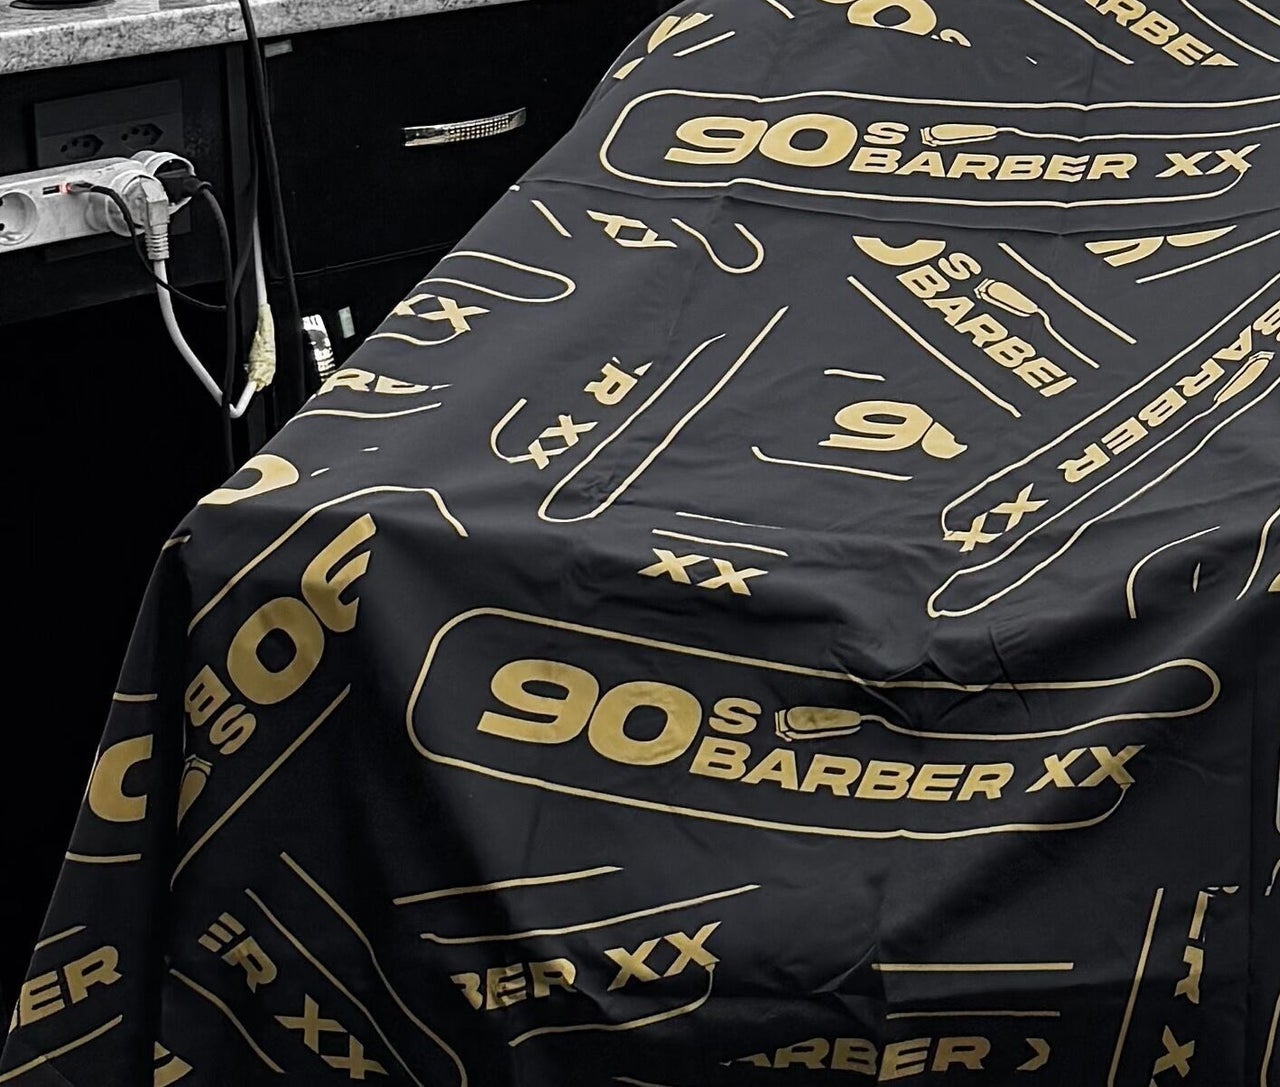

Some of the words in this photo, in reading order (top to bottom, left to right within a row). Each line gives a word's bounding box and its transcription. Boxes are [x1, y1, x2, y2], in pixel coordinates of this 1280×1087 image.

[665, 112, 911, 169] 90S
[848, 148, 1137, 184] BARBER
[1155, 143, 1262, 179] XX
[943, 483, 1050, 554] XX
[636, 547, 769, 597] XX
[475, 657, 764, 768] 90S
[688, 735, 1015, 803] BARBER
[1025, 744, 1147, 795] XX
[603, 921, 723, 993] XX
[273, 993, 391, 1082] XX
